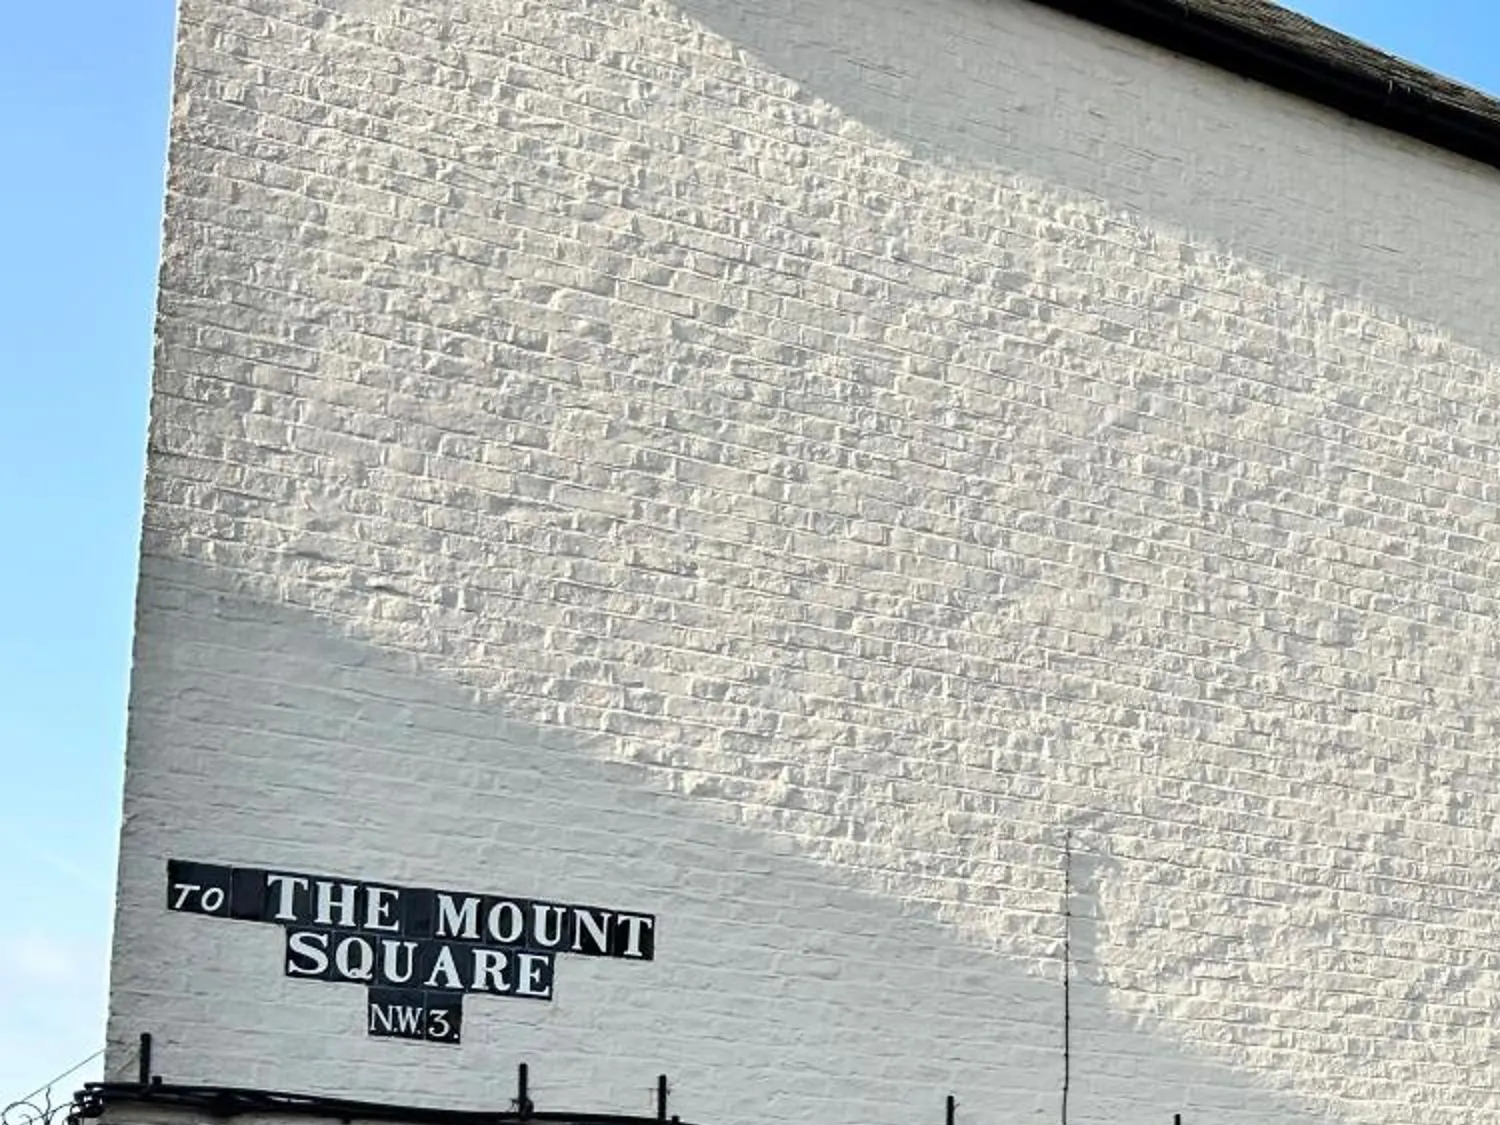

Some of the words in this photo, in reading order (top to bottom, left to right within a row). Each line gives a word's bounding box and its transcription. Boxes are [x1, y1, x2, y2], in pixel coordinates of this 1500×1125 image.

[173, 883, 225, 913] TO
[266, 874, 400, 931] THE
[436, 894, 655, 957] MOUNT
[287, 932, 551, 996] SQUARE
